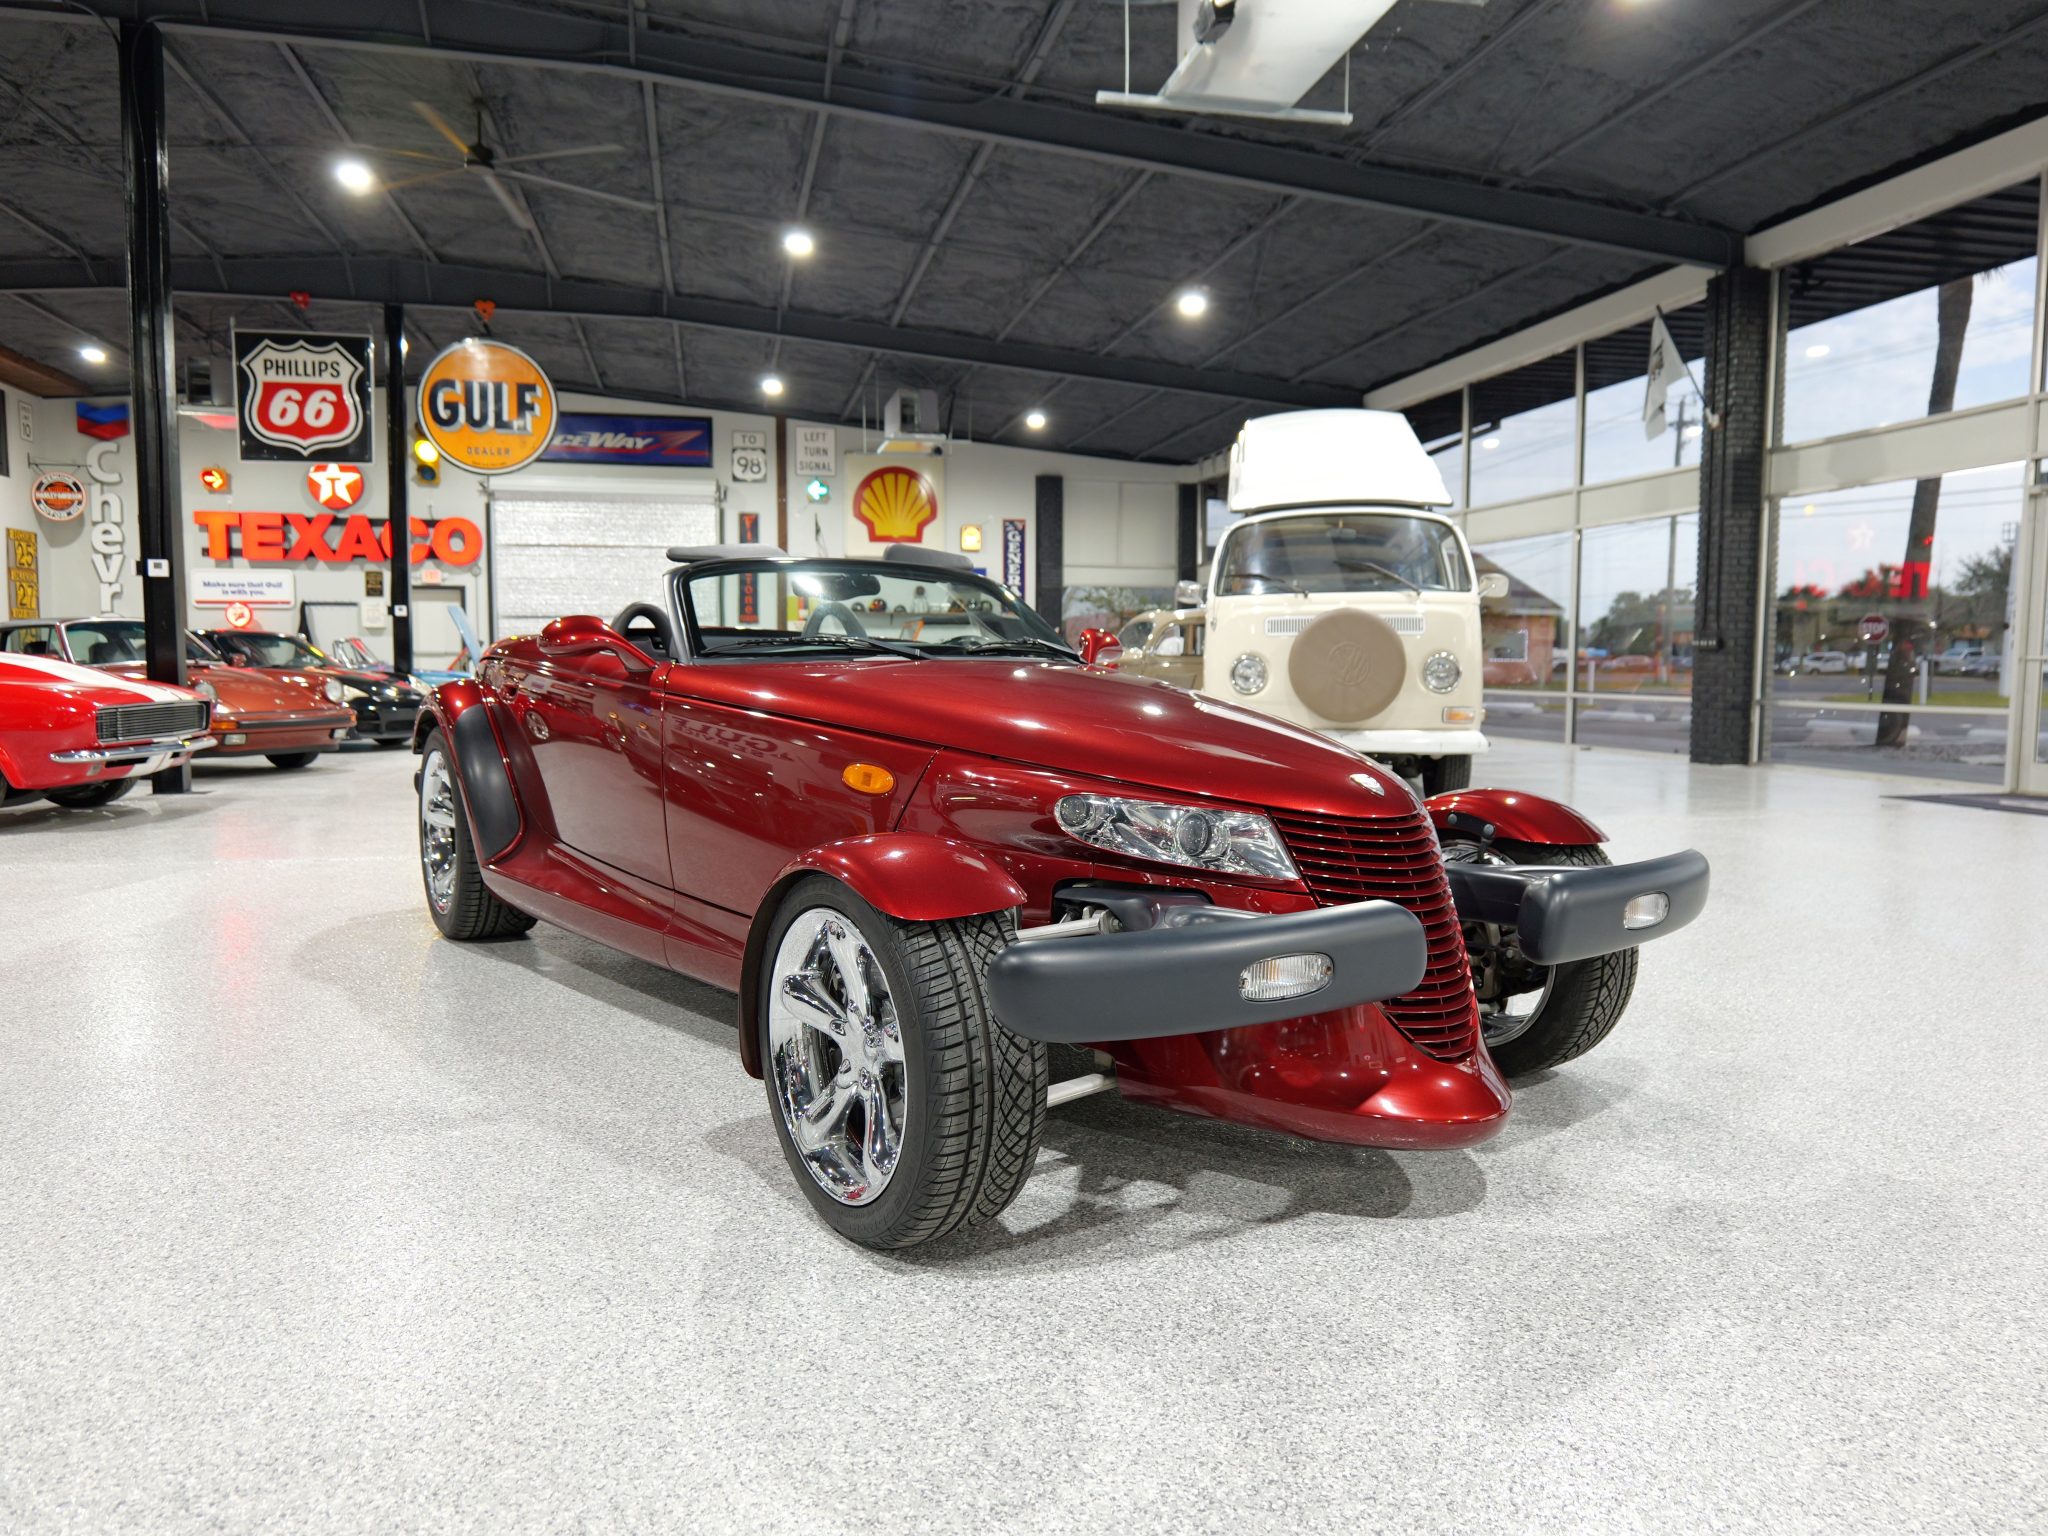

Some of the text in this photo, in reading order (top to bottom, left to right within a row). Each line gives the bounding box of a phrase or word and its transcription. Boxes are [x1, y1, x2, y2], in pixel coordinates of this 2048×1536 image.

[263, 358, 341, 378] PHILLIPS
[268, 388, 338, 428] 66
[429, 378, 543, 435] GULF
[741, 434, 757, 445] TO
[804, 431, 827, 442] LEFT
[466, 446, 511, 456] DEALER
[804, 446, 829, 457] TURN
[737, 456, 762, 475] 98
[799, 460, 833, 472] SIGNAL
[86, 442, 125, 618] Chevr
[17, 543, 34, 567] 25
[1007, 531, 1022, 598] GENERA
[18, 583, 35, 609] 27
[249, 589, 266, 597] you.
[1862, 622, 1887, 635] STOP
